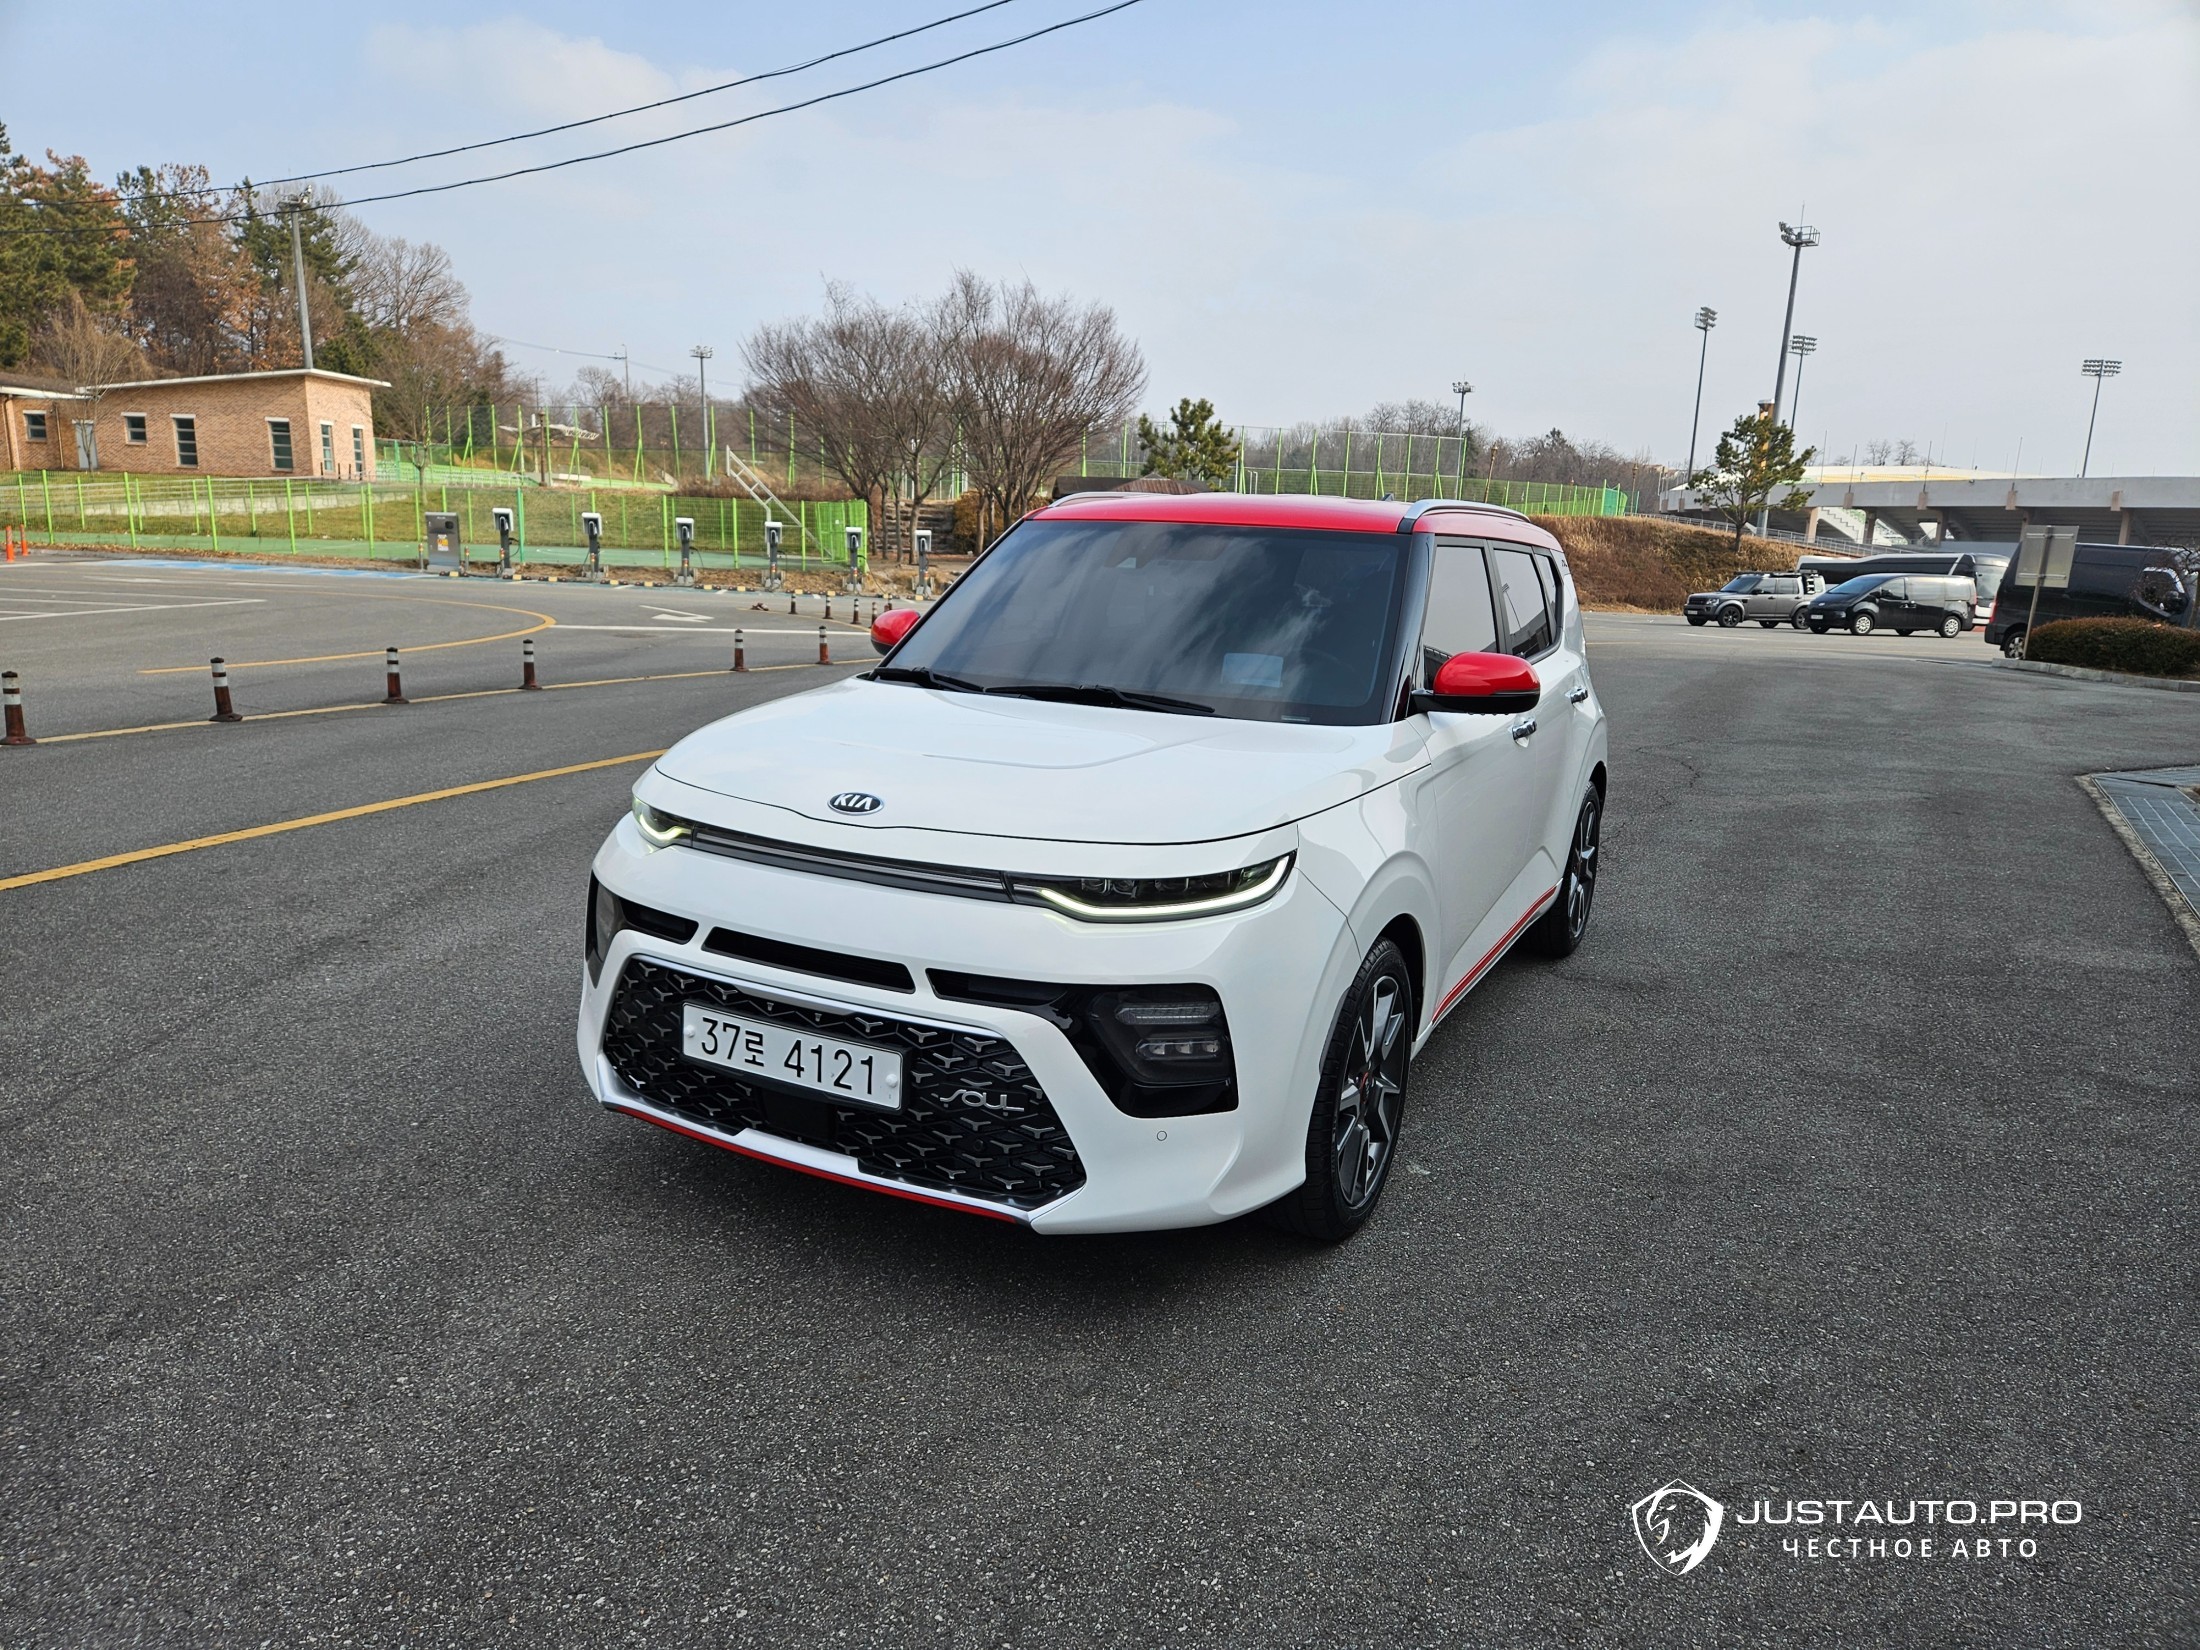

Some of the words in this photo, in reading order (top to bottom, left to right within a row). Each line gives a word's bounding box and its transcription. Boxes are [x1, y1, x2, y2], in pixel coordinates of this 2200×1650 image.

[833, 793, 873, 810] KIA
[701, 1017, 765, 1068] 37로
[783, 1039, 874, 1095] 4121
